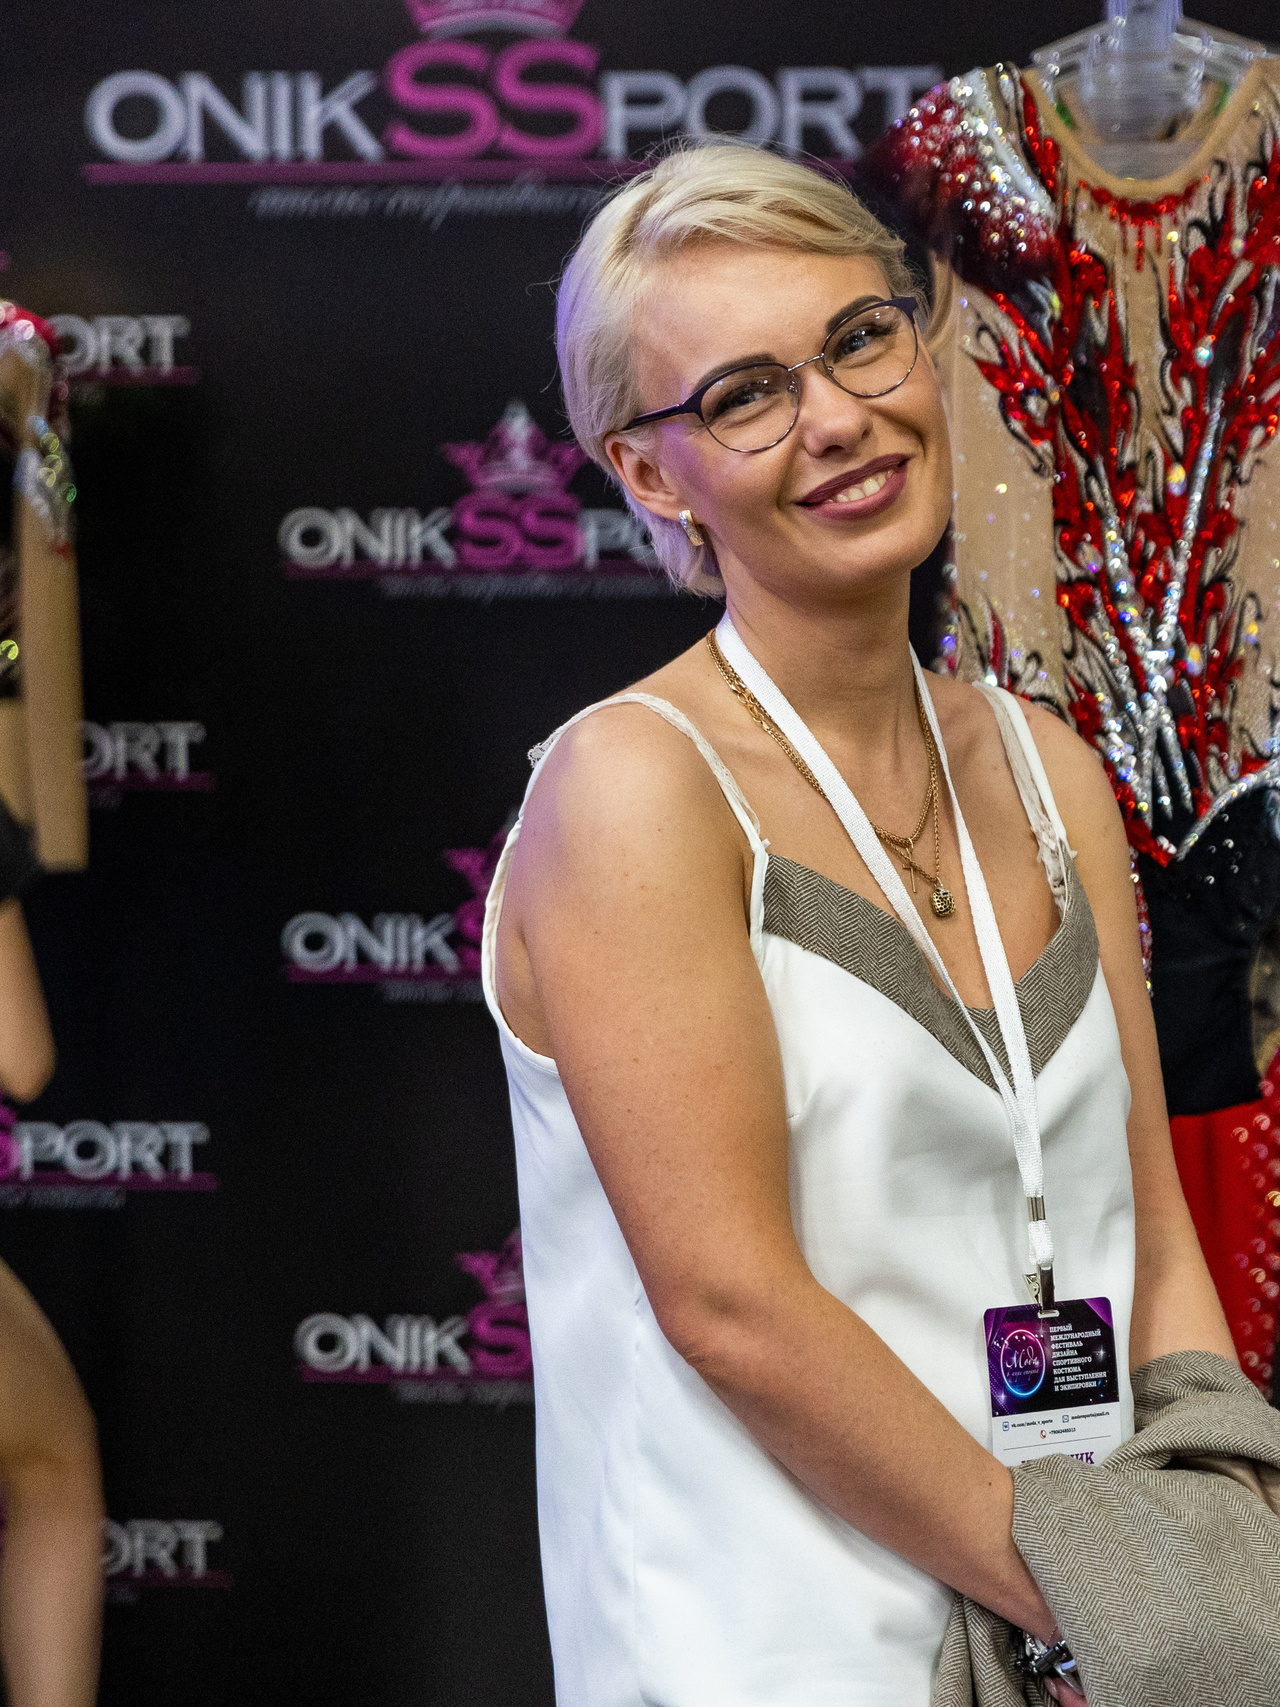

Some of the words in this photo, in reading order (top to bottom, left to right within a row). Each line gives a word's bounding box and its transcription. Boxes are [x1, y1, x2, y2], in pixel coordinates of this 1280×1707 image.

[84, 39, 944, 164] ONIKSSPORT
[1049, 1323, 1073, 1333] ПЕРВЫЙ
[1050, 1328, 1101, 1341] МЕЖДУНАРОДНЫЙ
[1051, 1341, 1083, 1349] ФЕСТИВАЛЬ
[1052, 1349, 1078, 1358] ДИЗАЙНА
[1052, 1356, 1092, 1366] СПОРТИВНОГО
[1053, 1366, 1081, 1375] КОСТЮМА
[1054, 1376, 1065, 1384] ДЛЯ
[1066, 1371, 1107, 1382] ВЫСТУПЛЕНИЯ
[1060, 1381, 1097, 1391] ЭКИПИРОВКИ
